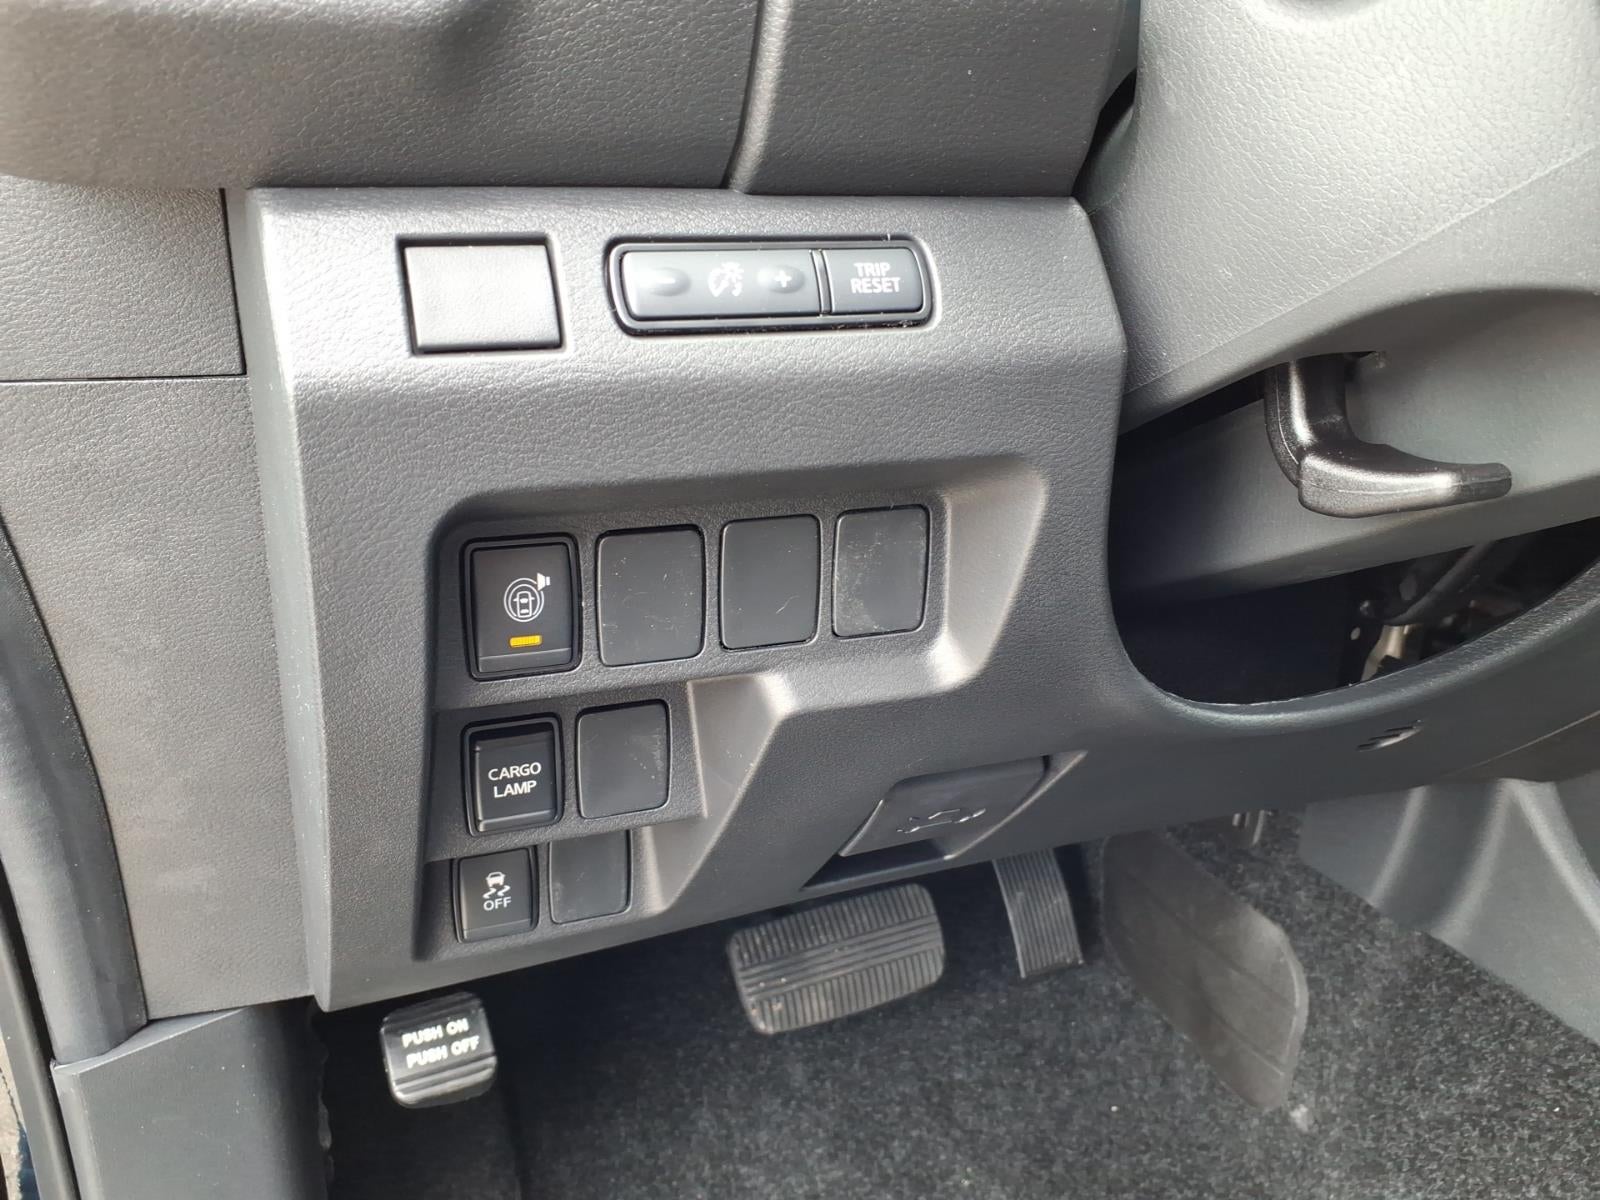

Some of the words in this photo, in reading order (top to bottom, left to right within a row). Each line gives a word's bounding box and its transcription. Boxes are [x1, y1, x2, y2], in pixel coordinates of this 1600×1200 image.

[853, 262, 891, 277] TRIP
[850, 277, 900, 294] RESET
[488, 762, 542, 781] CARGO
[493, 780, 537, 798] LAMP
[483, 896, 512, 911] OFF
[402, 1024, 443, 1048] PUSH
[446, 1018, 469, 1035] ON
[406, 1044, 448, 1069] PUSH
[450, 1035, 479, 1056] OFF
